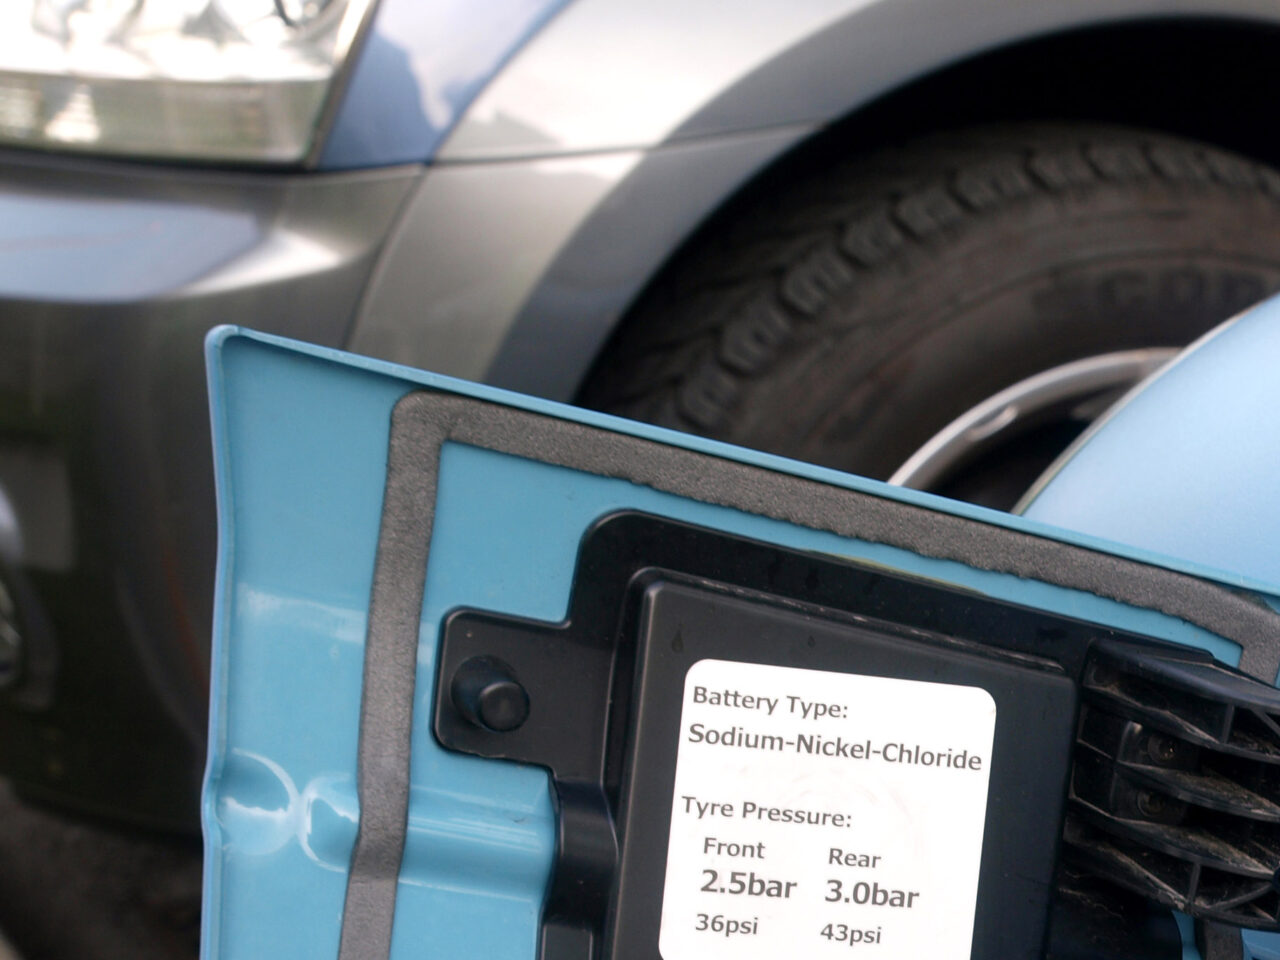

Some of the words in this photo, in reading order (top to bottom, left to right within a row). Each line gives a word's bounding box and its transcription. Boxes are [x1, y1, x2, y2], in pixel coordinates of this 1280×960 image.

[692, 685, 779, 715] Battery
[786, 695, 849, 720] Type:
[687, 722, 983, 771] Sodium-Nickel-Chloride
[681, 795, 734, 819] Tyre
[742, 801, 852, 828] Pressure:
[703, 836, 766, 859] Front
[828, 847, 882, 869] Rear
[700, 869, 797, 899] 2.5bar
[824, 879, 920, 909] 3.0bar
[695, 913, 759, 938] 36psi
[820, 923, 882, 947] 43psi
